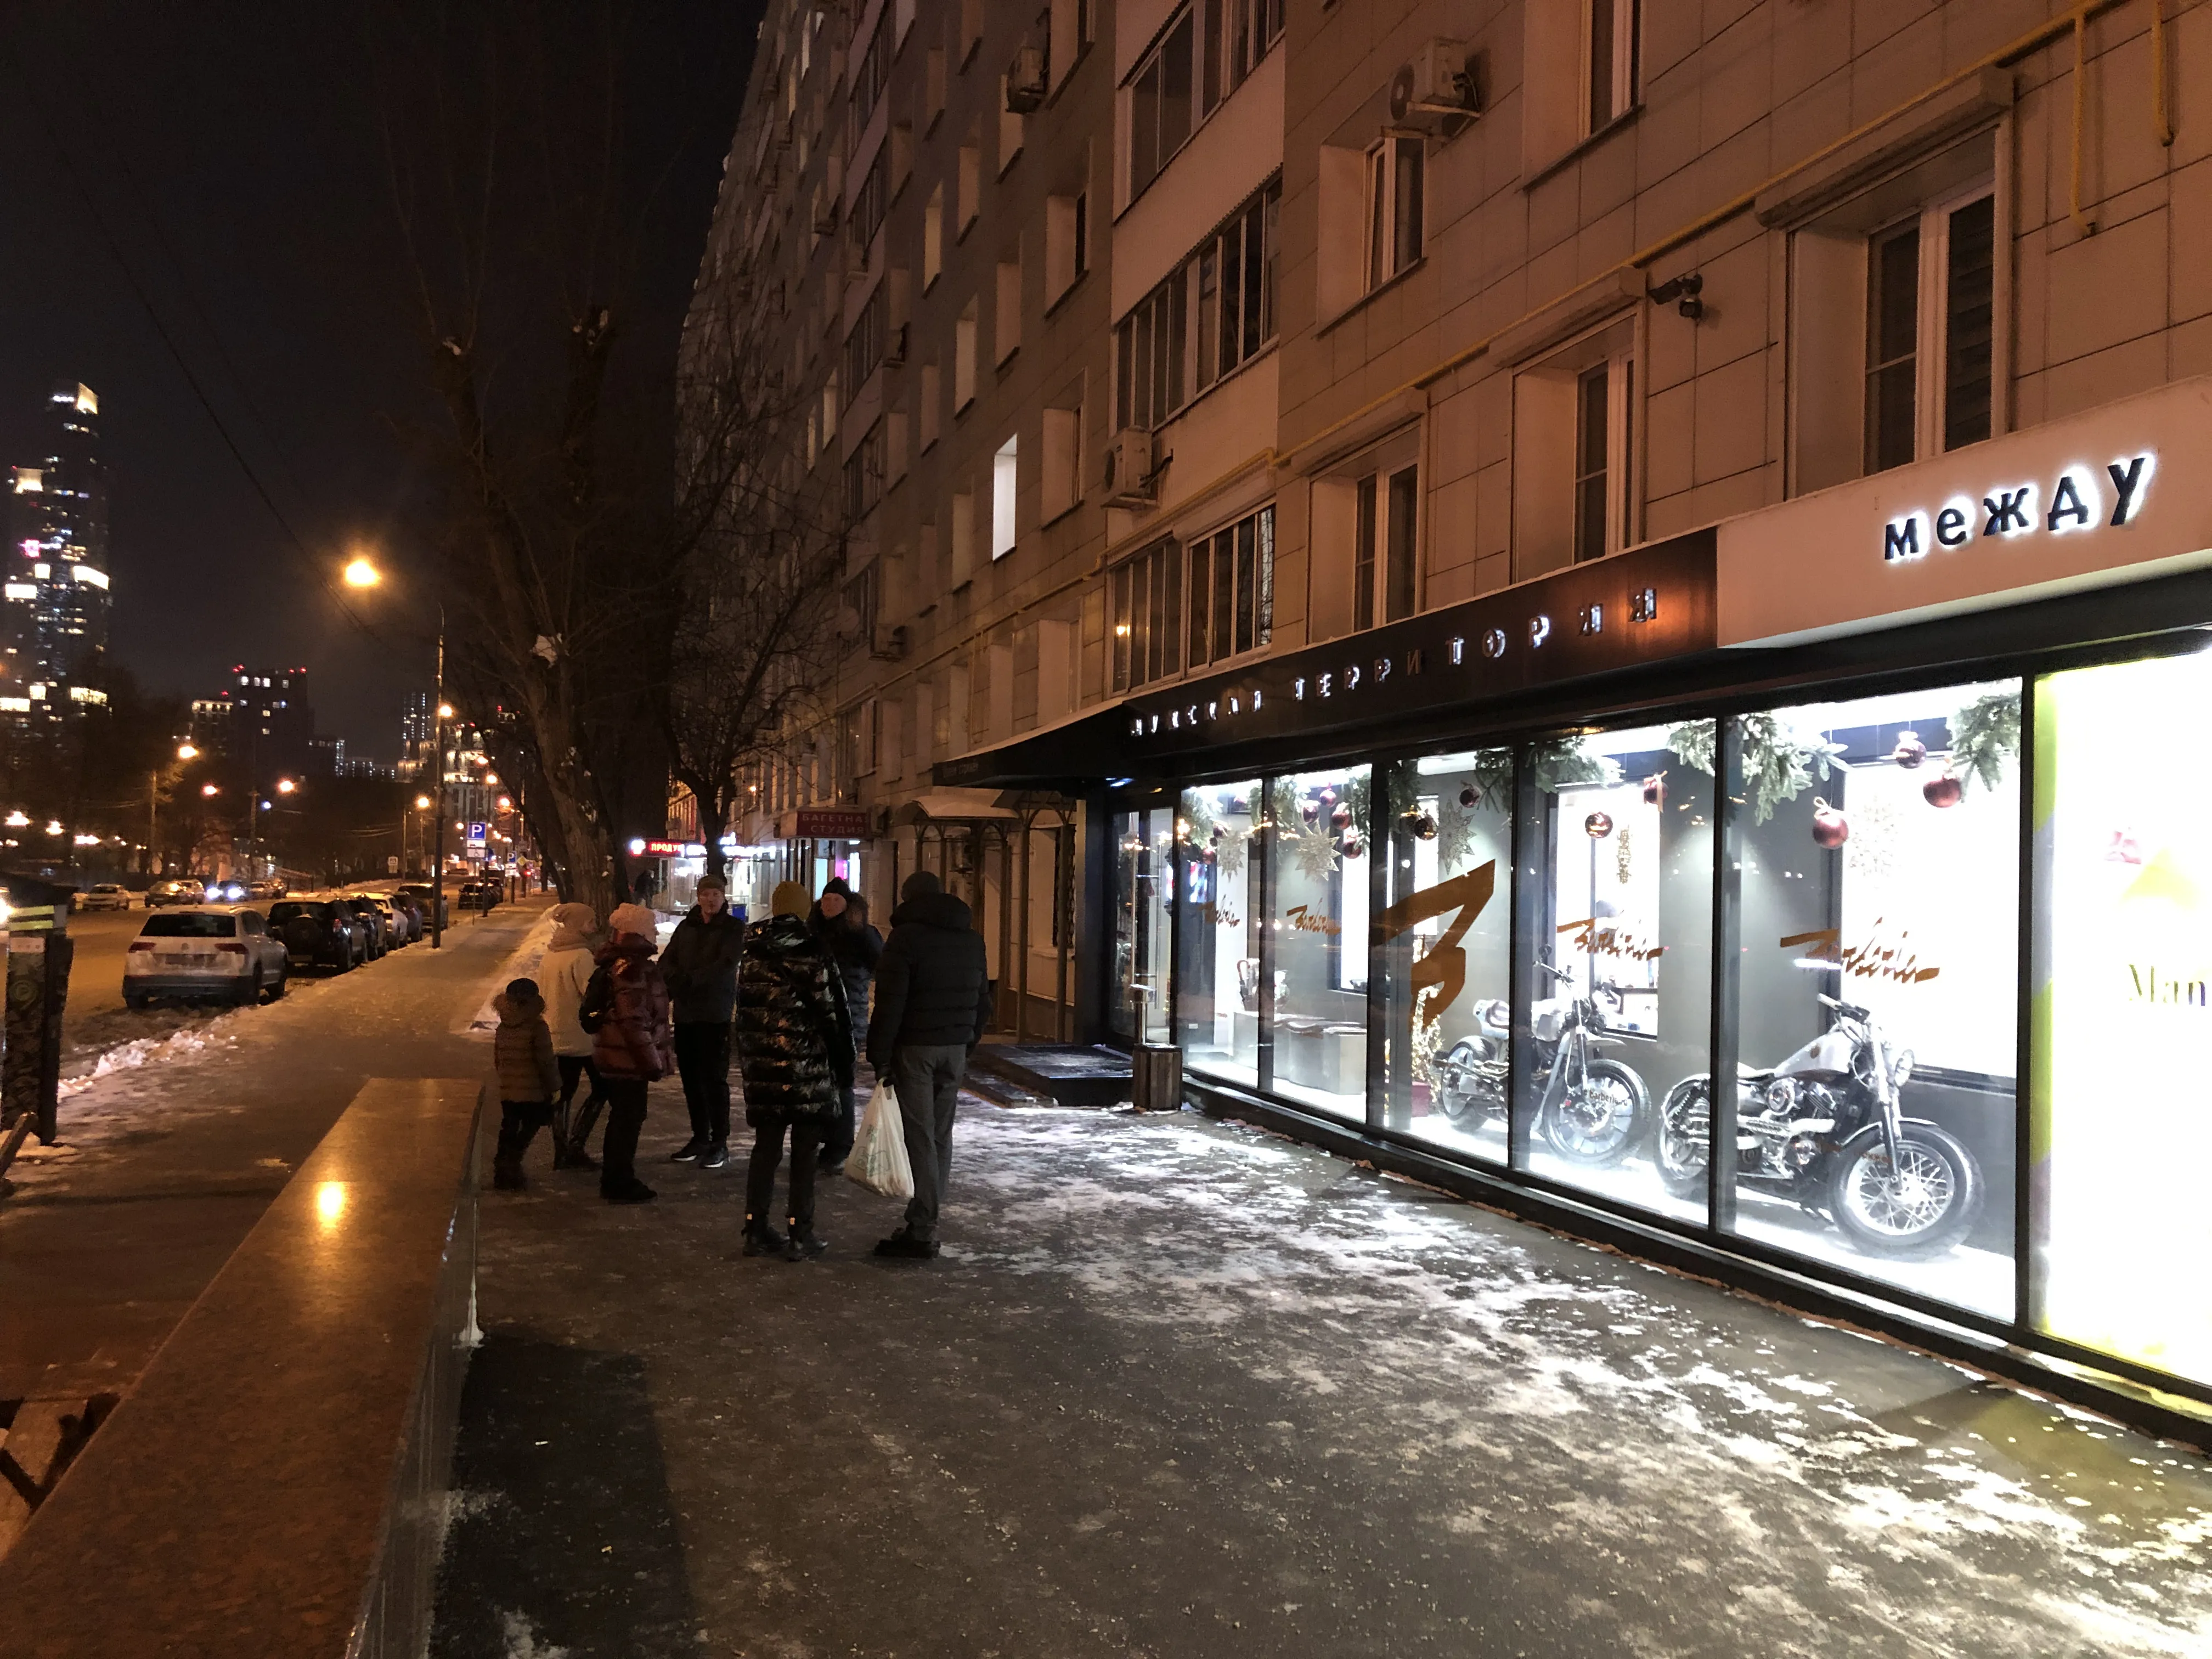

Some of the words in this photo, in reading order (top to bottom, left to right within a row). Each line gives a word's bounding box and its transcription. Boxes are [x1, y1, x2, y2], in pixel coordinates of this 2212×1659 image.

[1884, 457, 2146, 560] между
[1290, 588, 1657, 701] ТЕРРИТОРИЯ
[471, 824, 482, 837] P
[810, 825, 865, 834] СТУДИЯ
